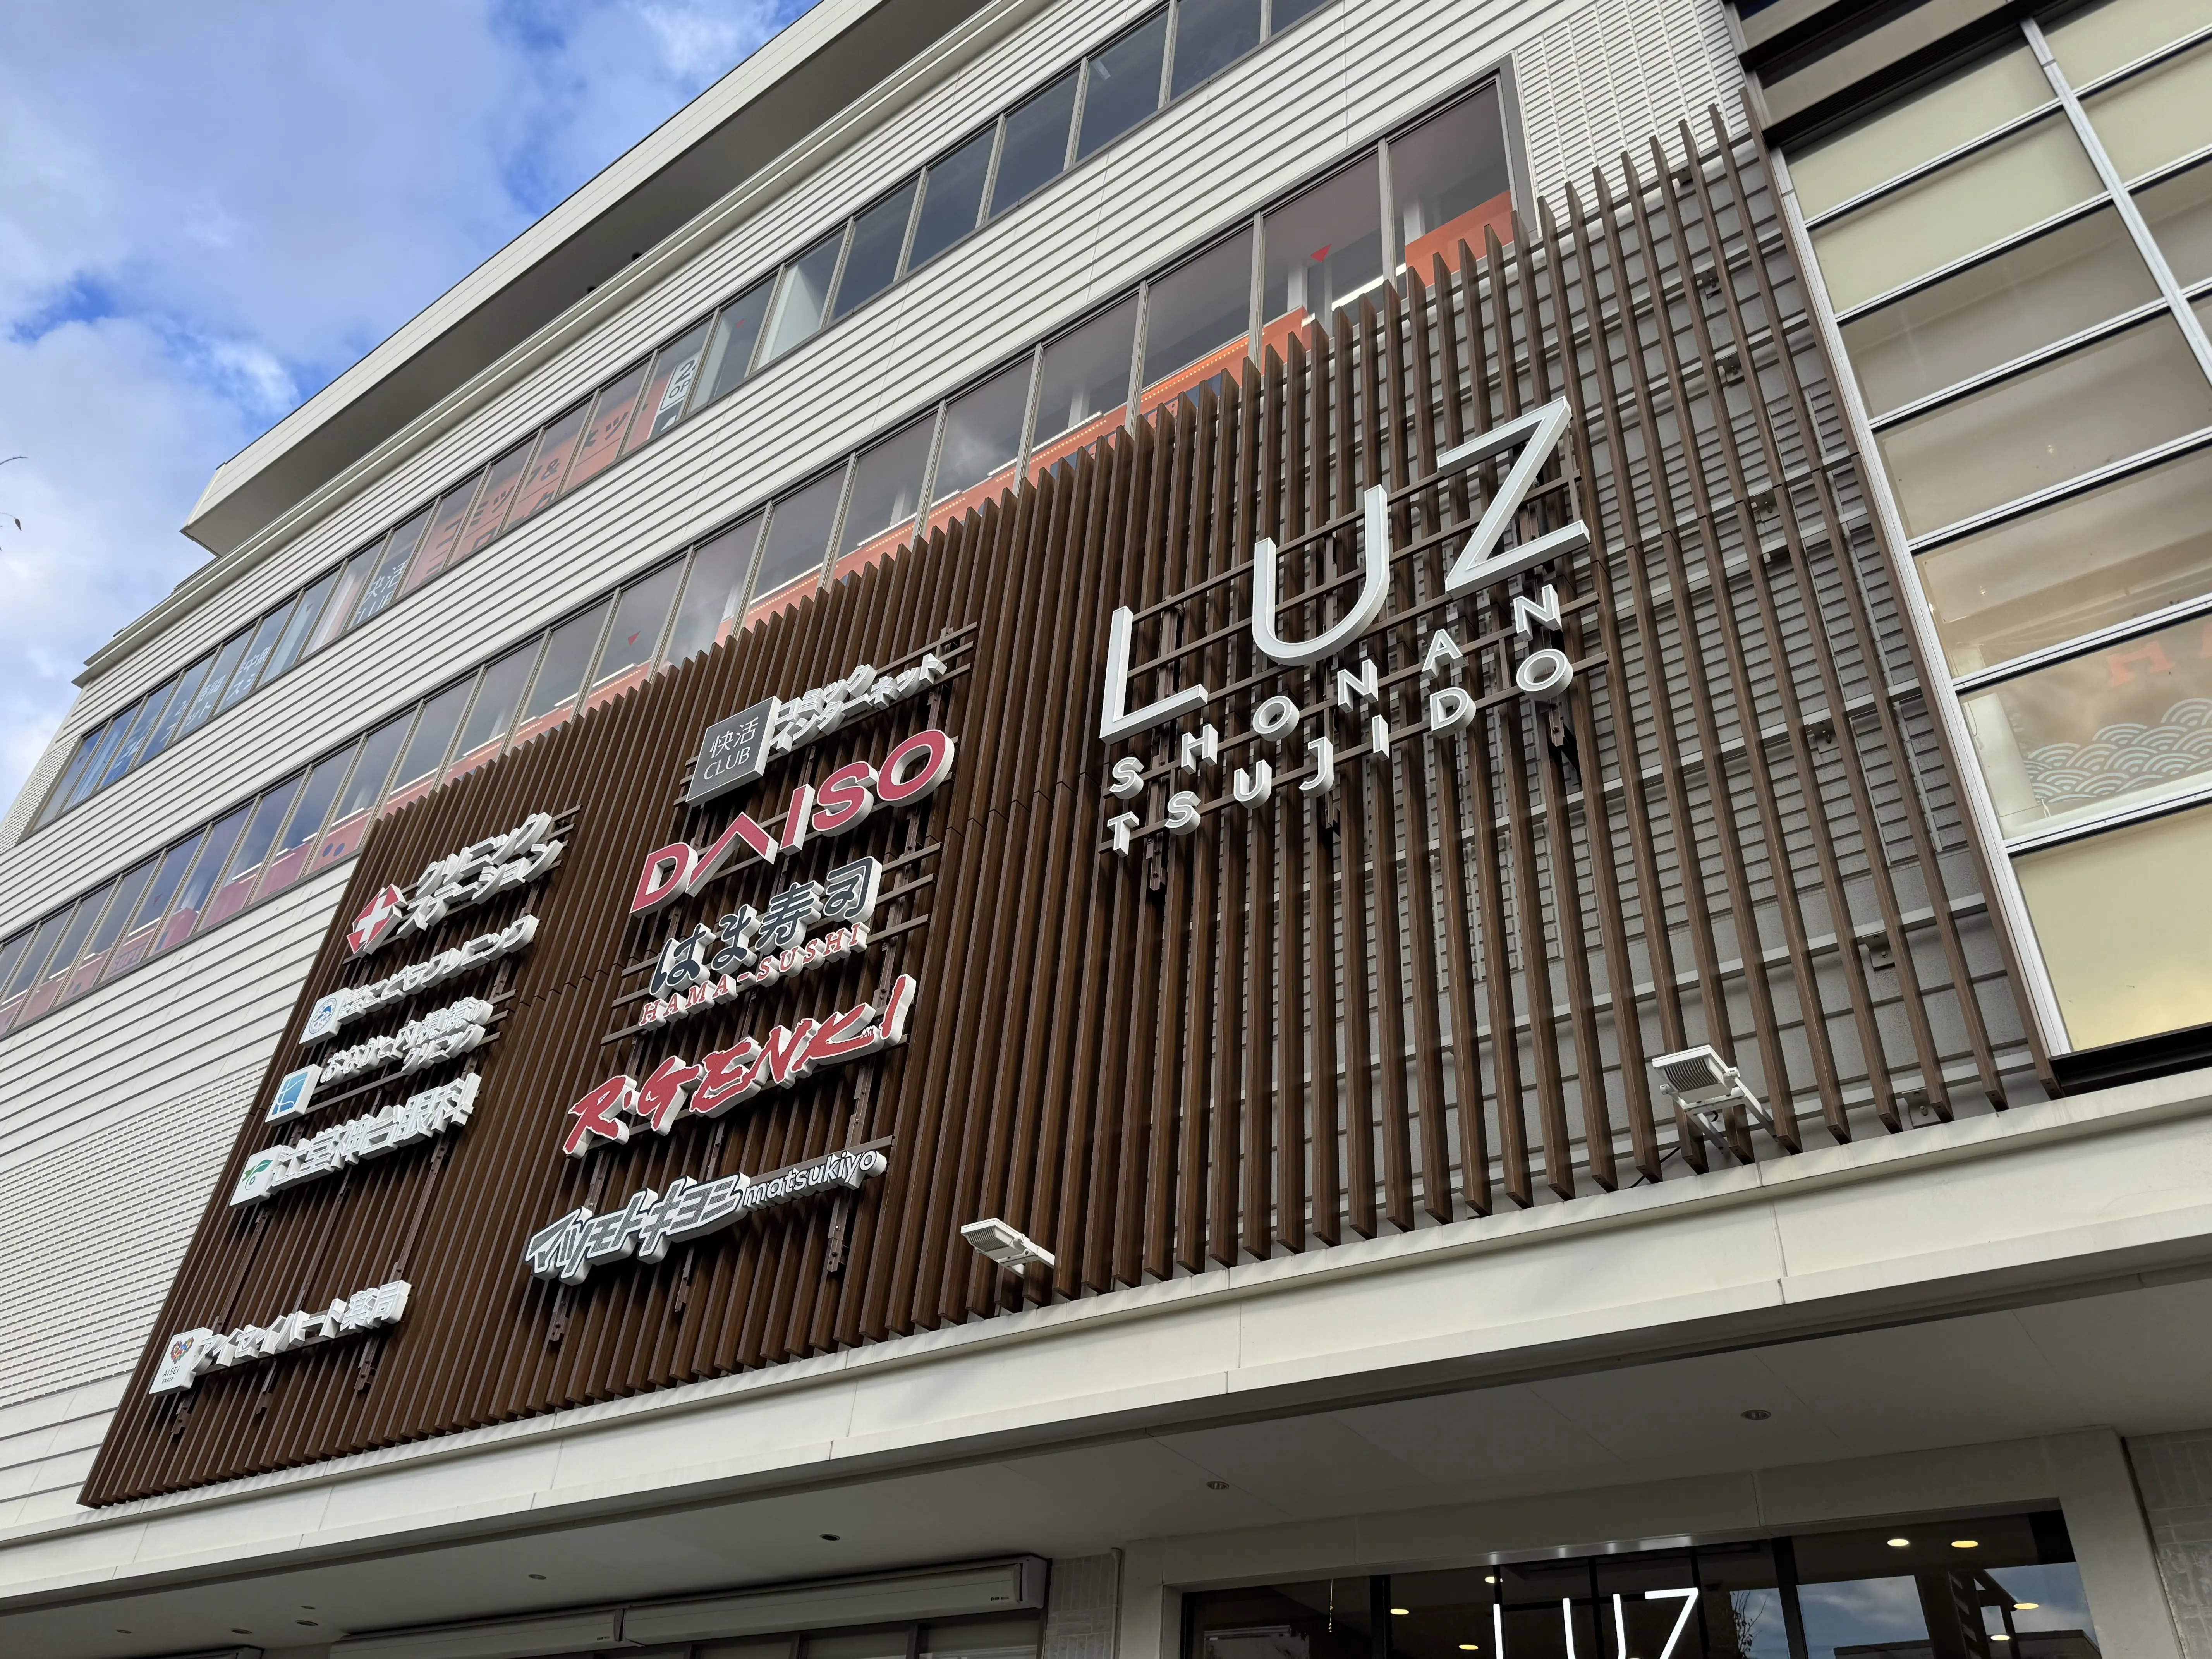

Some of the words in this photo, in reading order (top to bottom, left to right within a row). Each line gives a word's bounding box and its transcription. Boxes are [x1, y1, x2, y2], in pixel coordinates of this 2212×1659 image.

[1100, 396, 1590, 744] LUZ
[709, 716, 759, 759] 快活
[770, 653, 947, 753] インターネット
[775, 664, 877, 729] コミック
[1109, 584, 1562, 800] SHONAN
[704, 746, 750, 780] CLUB
[1107, 648, 1574, 856] TSUJIDO
[415, 812, 551, 898] クリニック
[630, 729, 953, 917] DAISO
[397, 840, 563, 940] ステーション
[649, 856, 881, 998] はま寿司
[362, 914, 540, 1012] こどもクリニック
[639, 922, 867, 1029] HAMA-SUSHI
[321, 996, 493, 1083] おなかと内視鏡の
[402, 1024, 485, 1076] クリニック
[270, 1072, 481, 1192] 辻堂神台眼科
[744, 1149, 886, 1209] matsukiyo
[524, 1171, 750, 1284] マツモトキヨシ
[162, 1365, 180, 1377] AISEI
[191, 1280, 410, 1373] アイセイハート薬局
